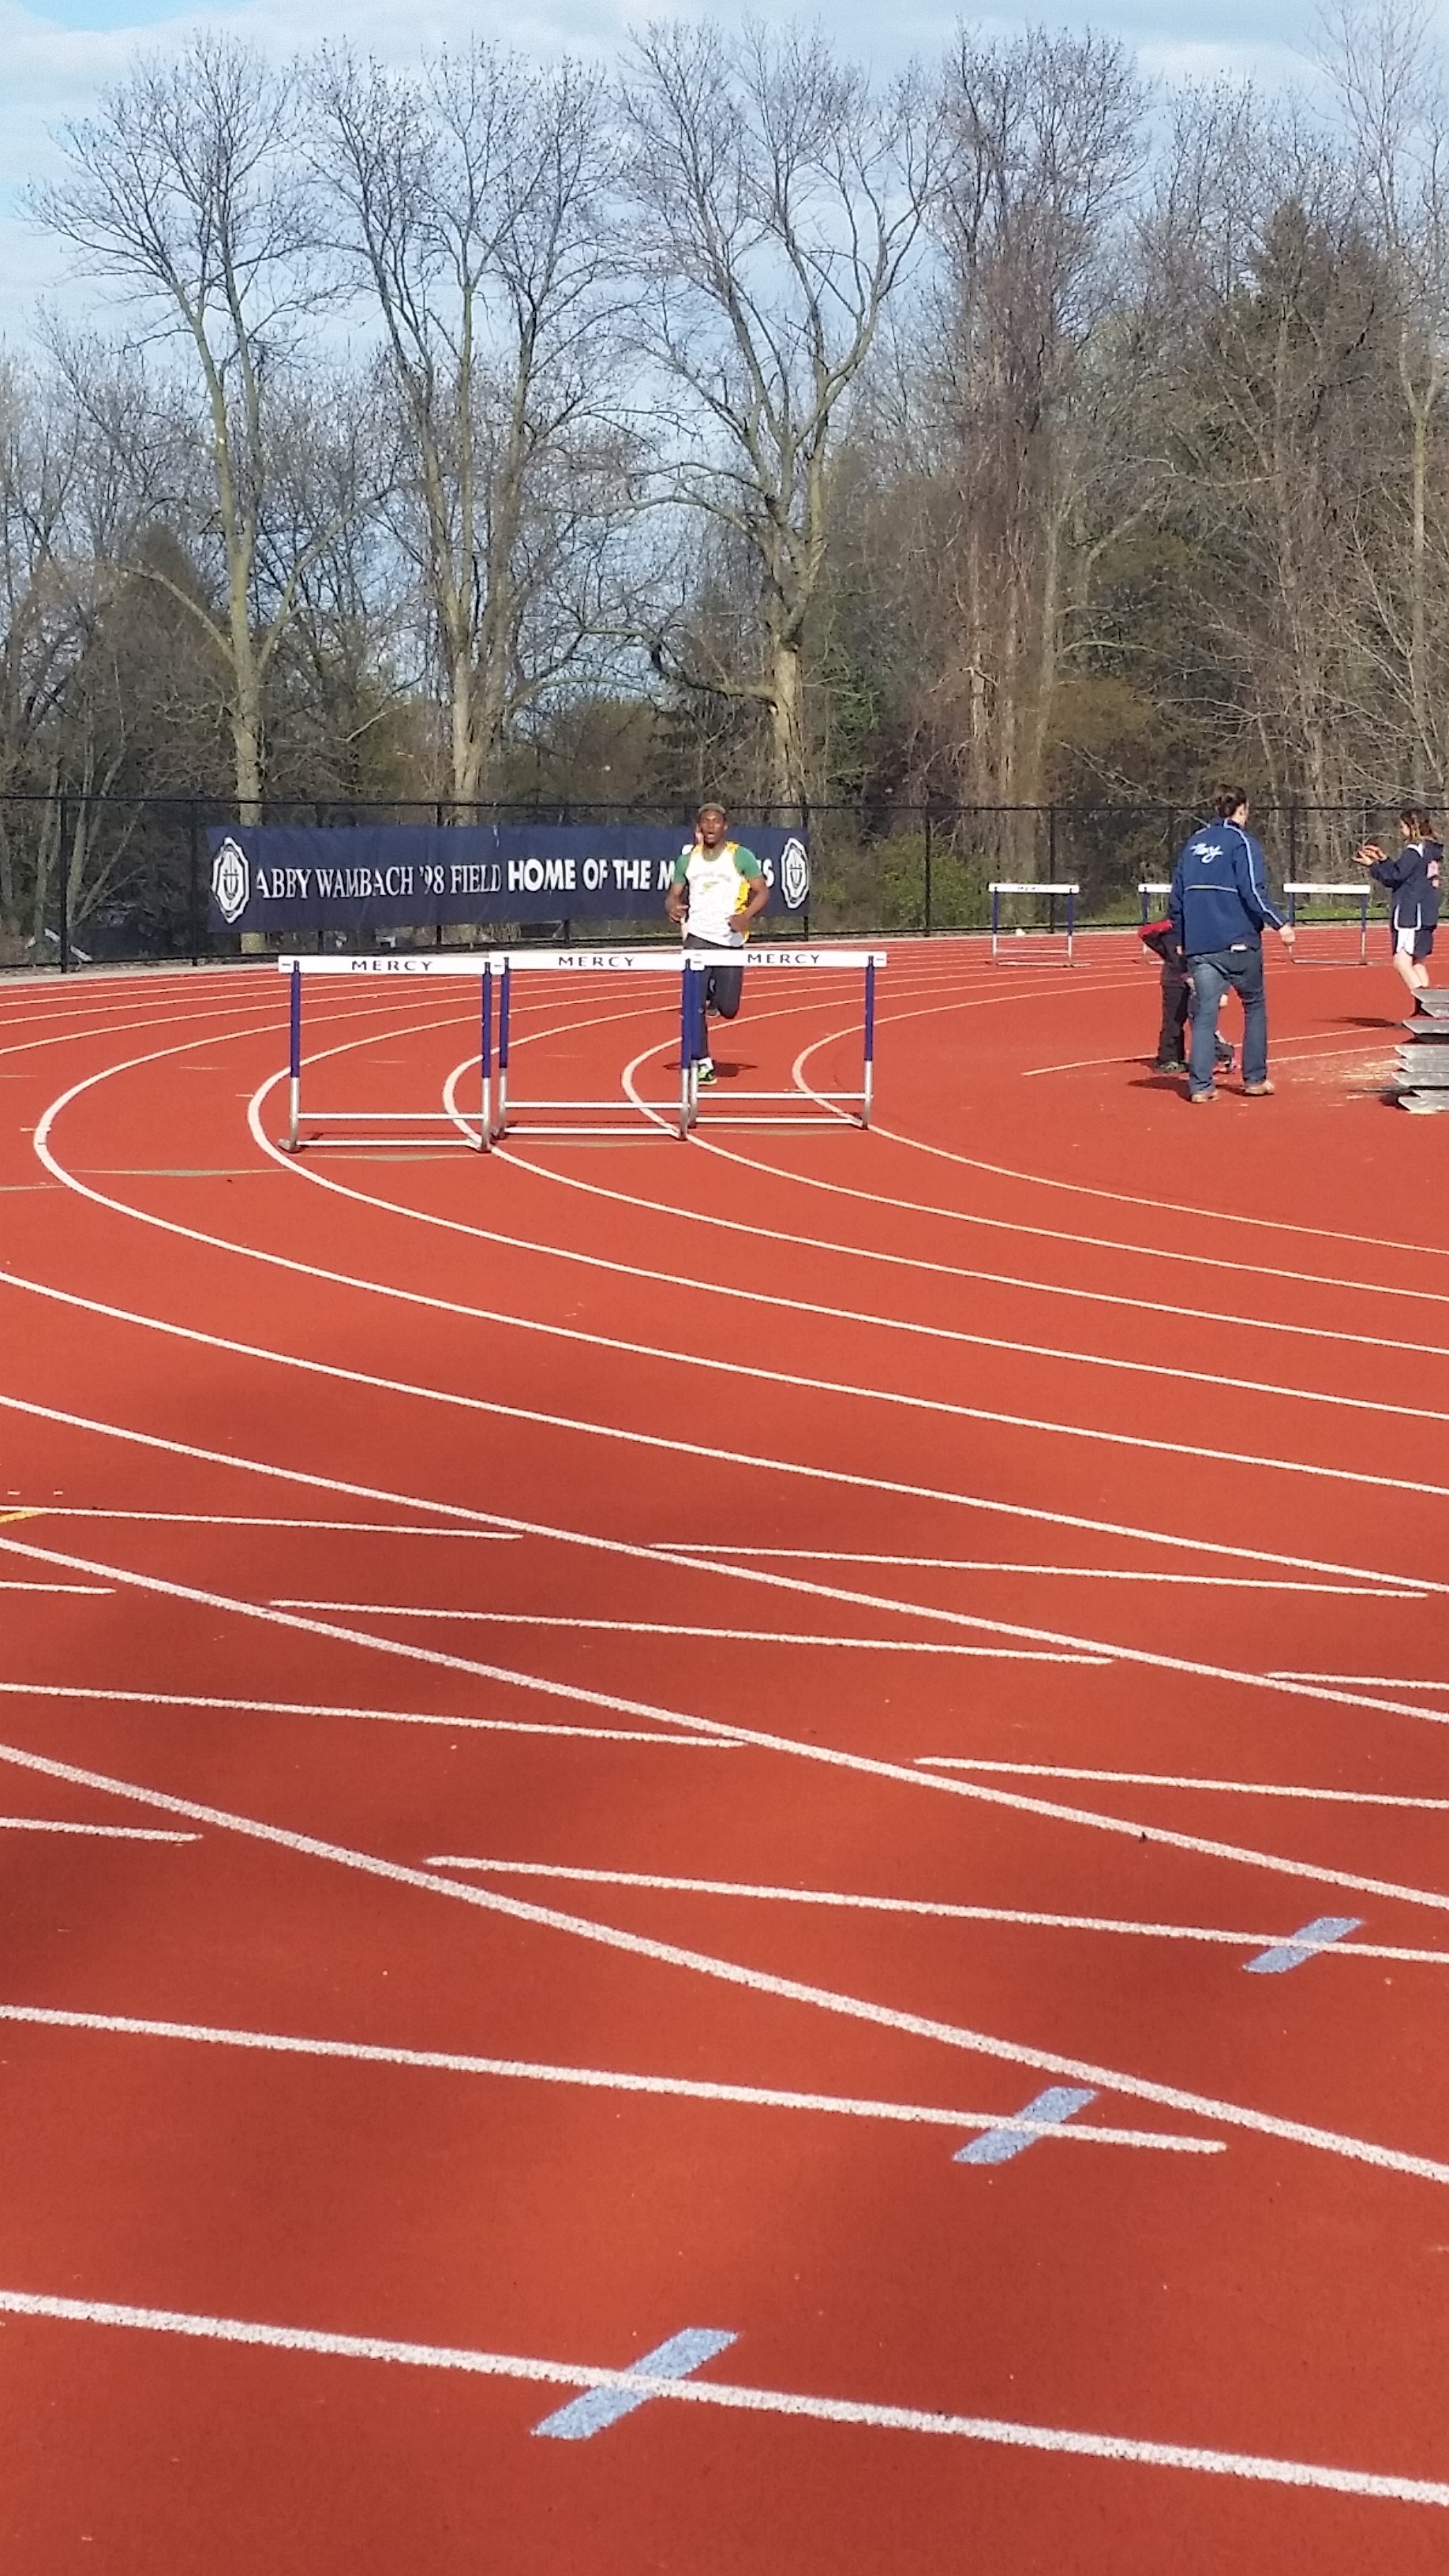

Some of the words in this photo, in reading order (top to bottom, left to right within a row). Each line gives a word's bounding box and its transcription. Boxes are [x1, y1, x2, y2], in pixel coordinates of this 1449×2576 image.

[256, 868, 310, 899] ABBY
[316, 866, 414, 898] WAMBACH
[419, 865, 444, 895] '98
[450, 864, 501, 894] FIELD
[507, 858, 576, 892] HOME
[582, 858, 608, 890] OF
[612, 859, 651, 890] THE
[558, 956, 635, 967] MERCY
[747, 953, 820, 964] MERCY
[352, 960, 433, 971] MERCY
